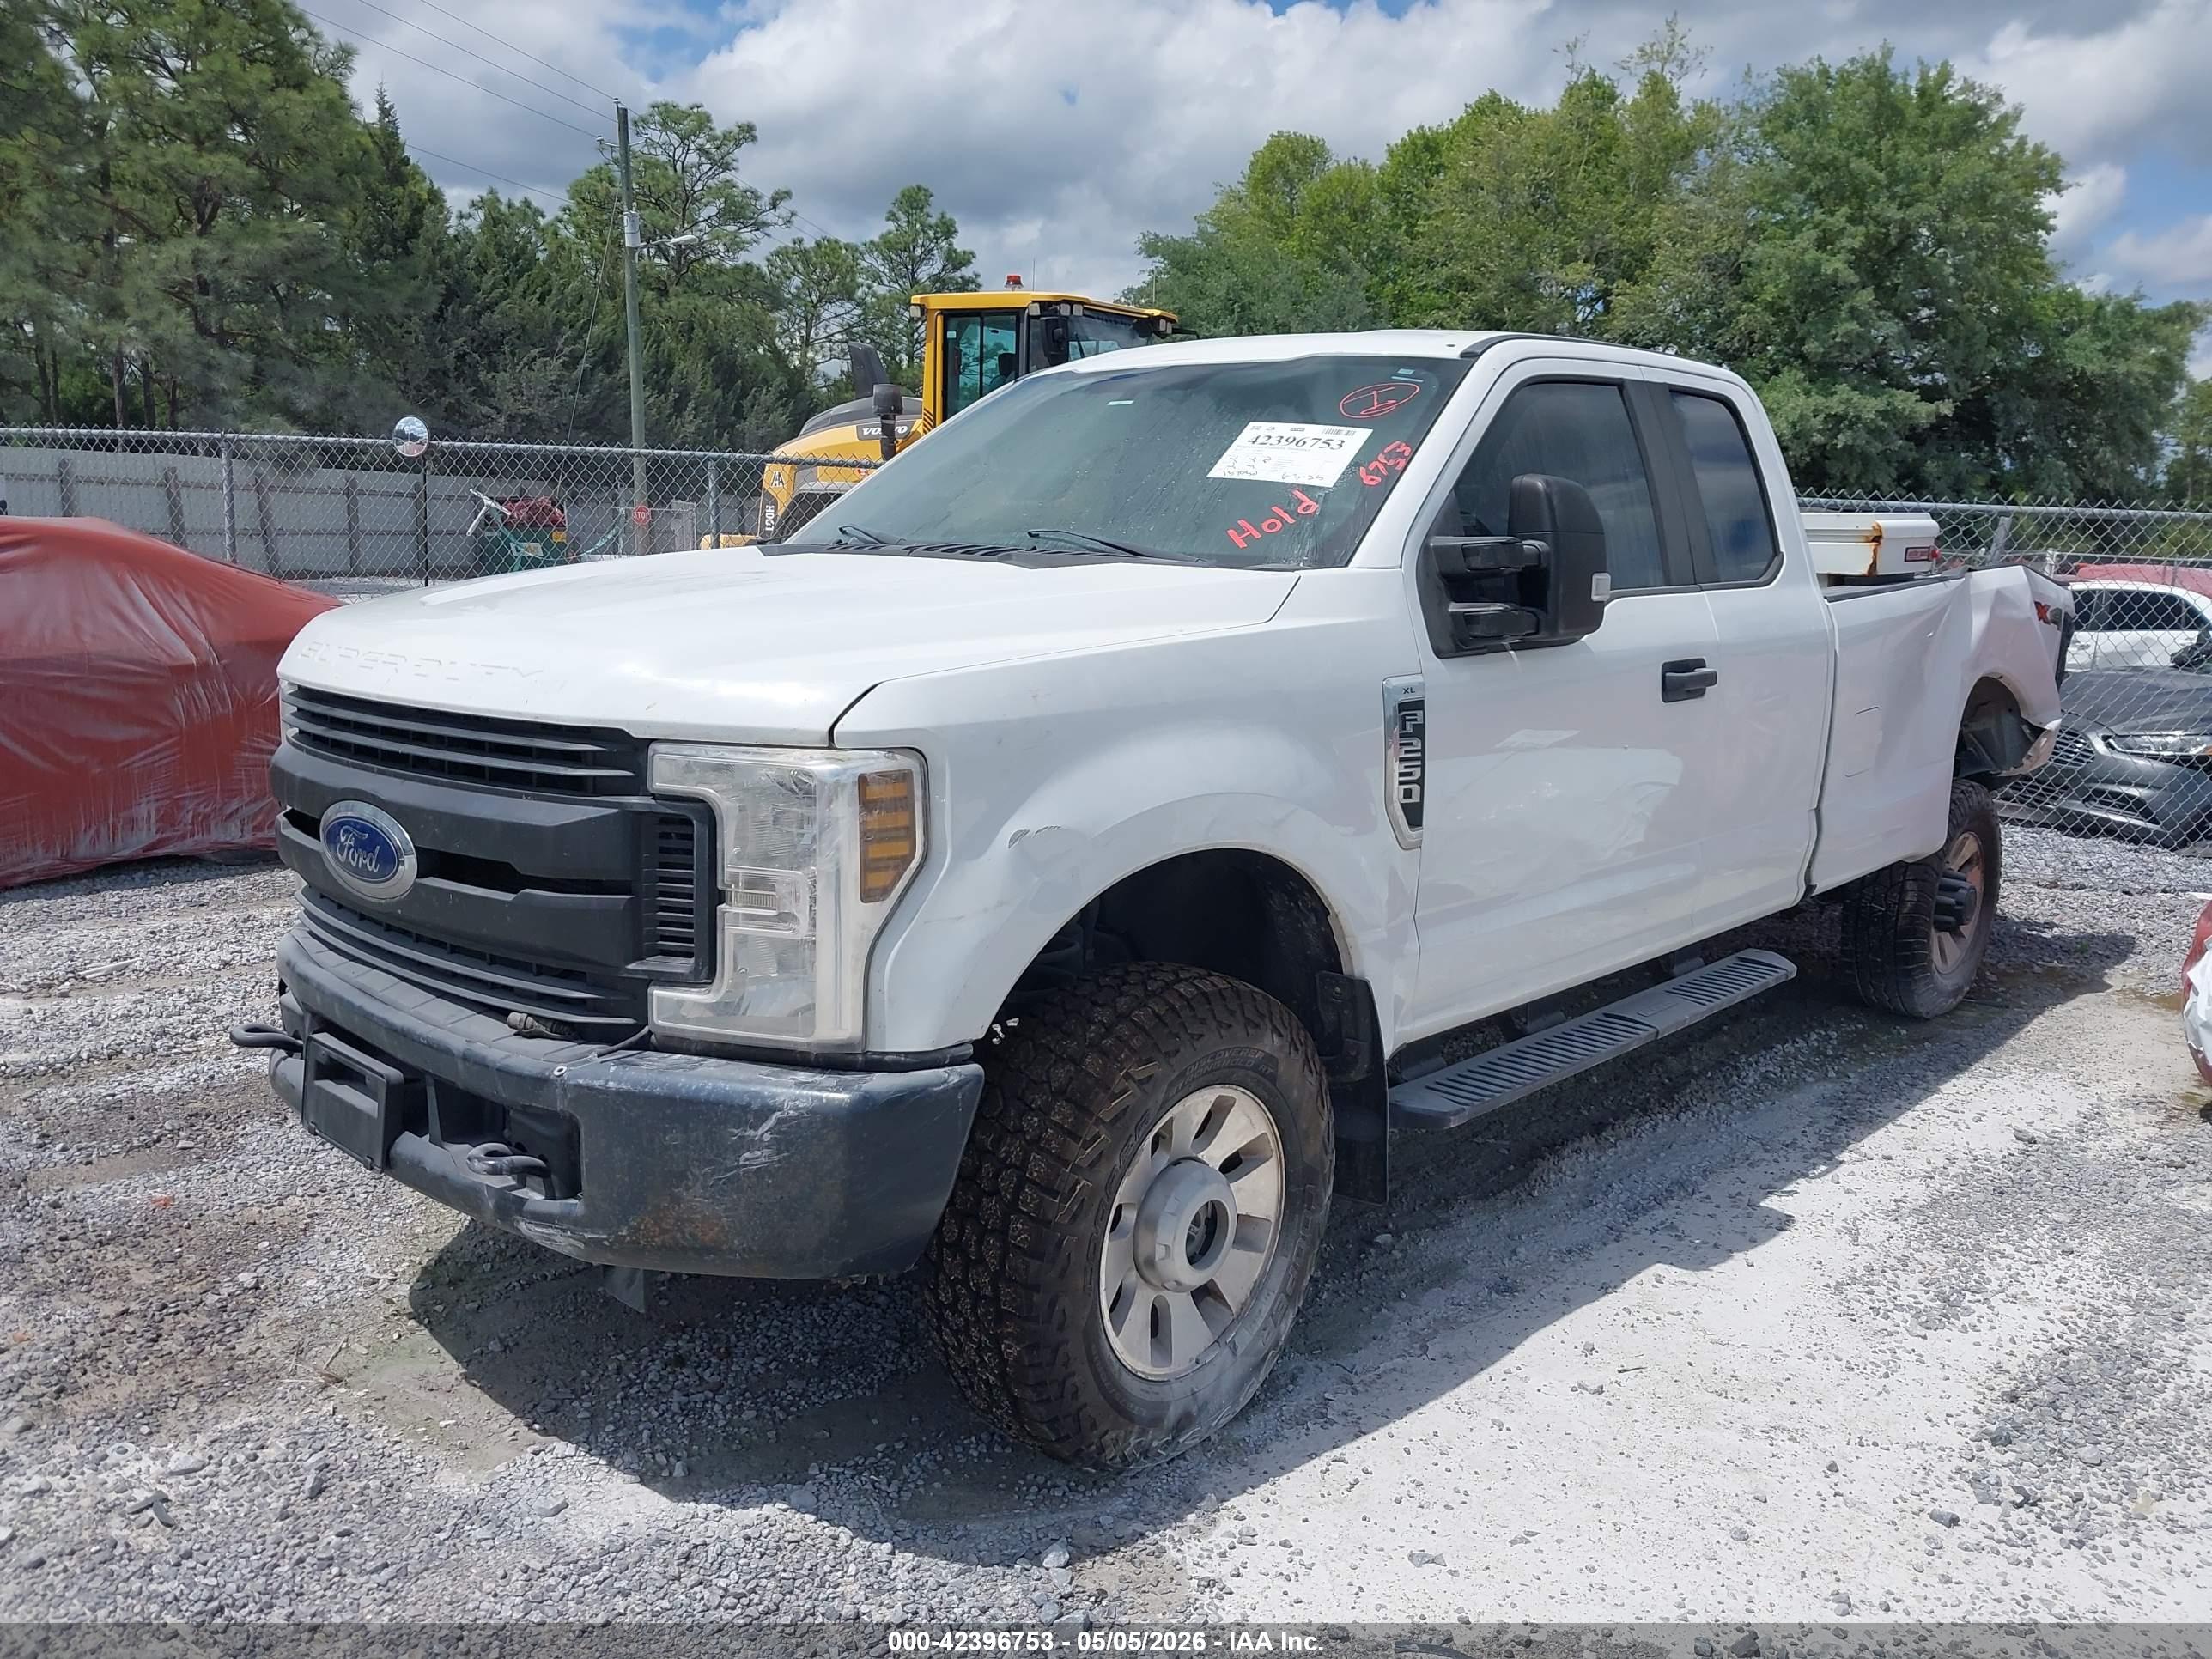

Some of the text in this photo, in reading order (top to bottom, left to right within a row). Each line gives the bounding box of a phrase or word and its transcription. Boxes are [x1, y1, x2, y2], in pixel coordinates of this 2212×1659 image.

[862, 426, 908, 435] VOVO
[1247, 434, 1346, 451] 42396753
[1359, 440, 1412, 486] 6753
[1226, 489, 1319, 549] Hold
[336, 824, 380, 874] Ford
[1185, 1048, 1265, 1075] DISCOVERER
